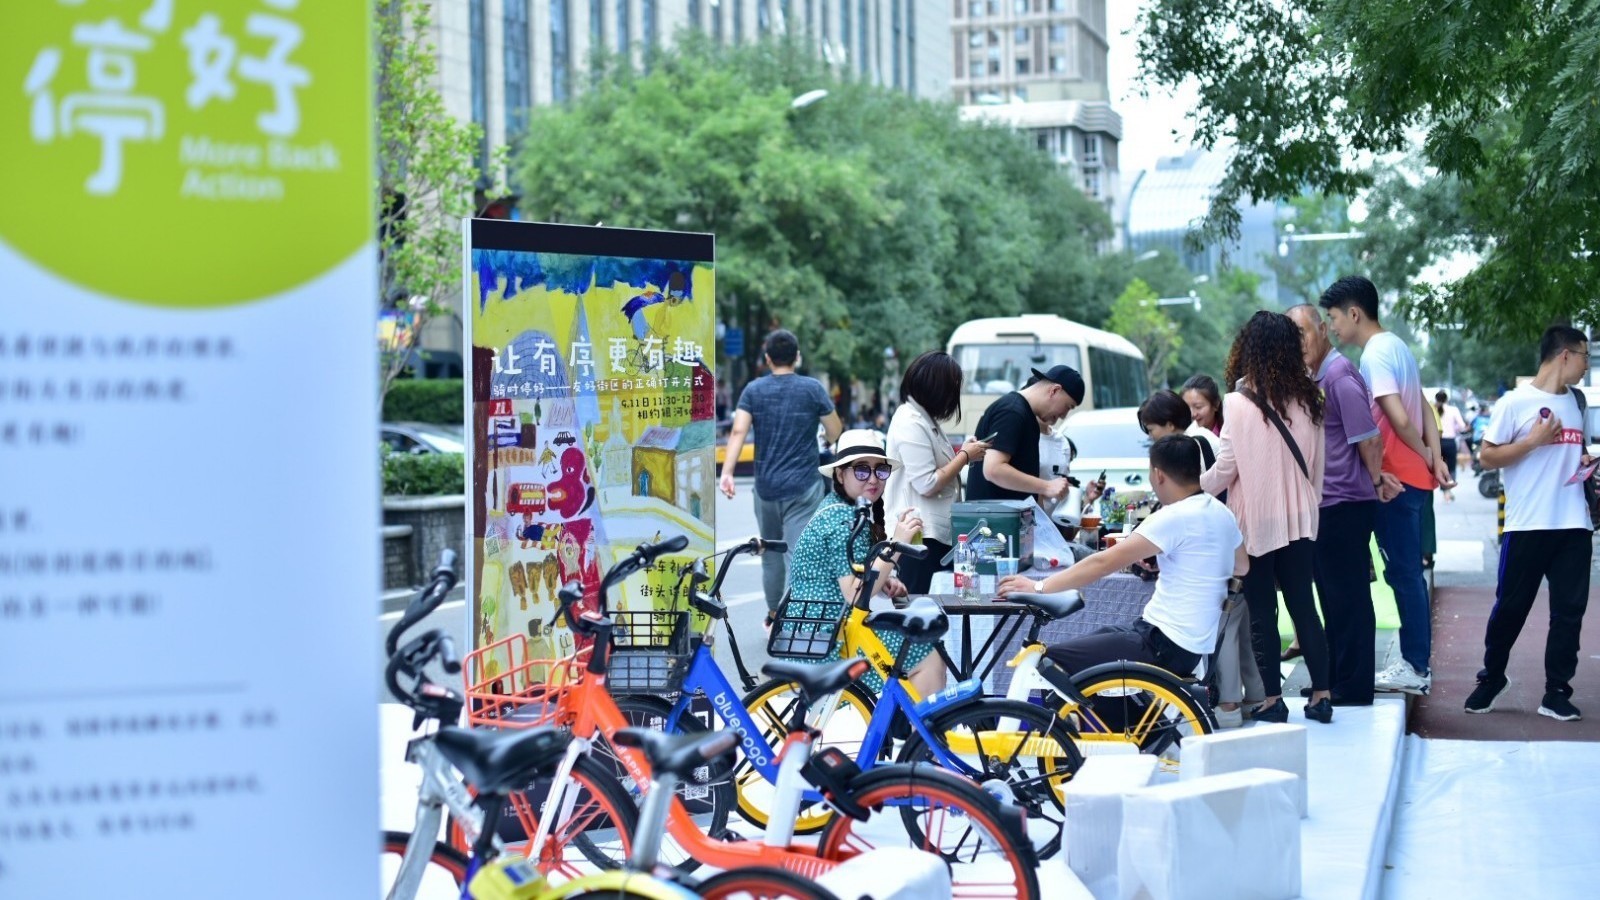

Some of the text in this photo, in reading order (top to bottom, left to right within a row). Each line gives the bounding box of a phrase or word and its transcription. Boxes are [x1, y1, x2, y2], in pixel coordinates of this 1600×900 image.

[24, 13, 313, 196] 停好
[180, 136, 341, 171] More Back
[180, 169, 284, 200] Action
[491, 335, 704, 377] 让有序更有趣
